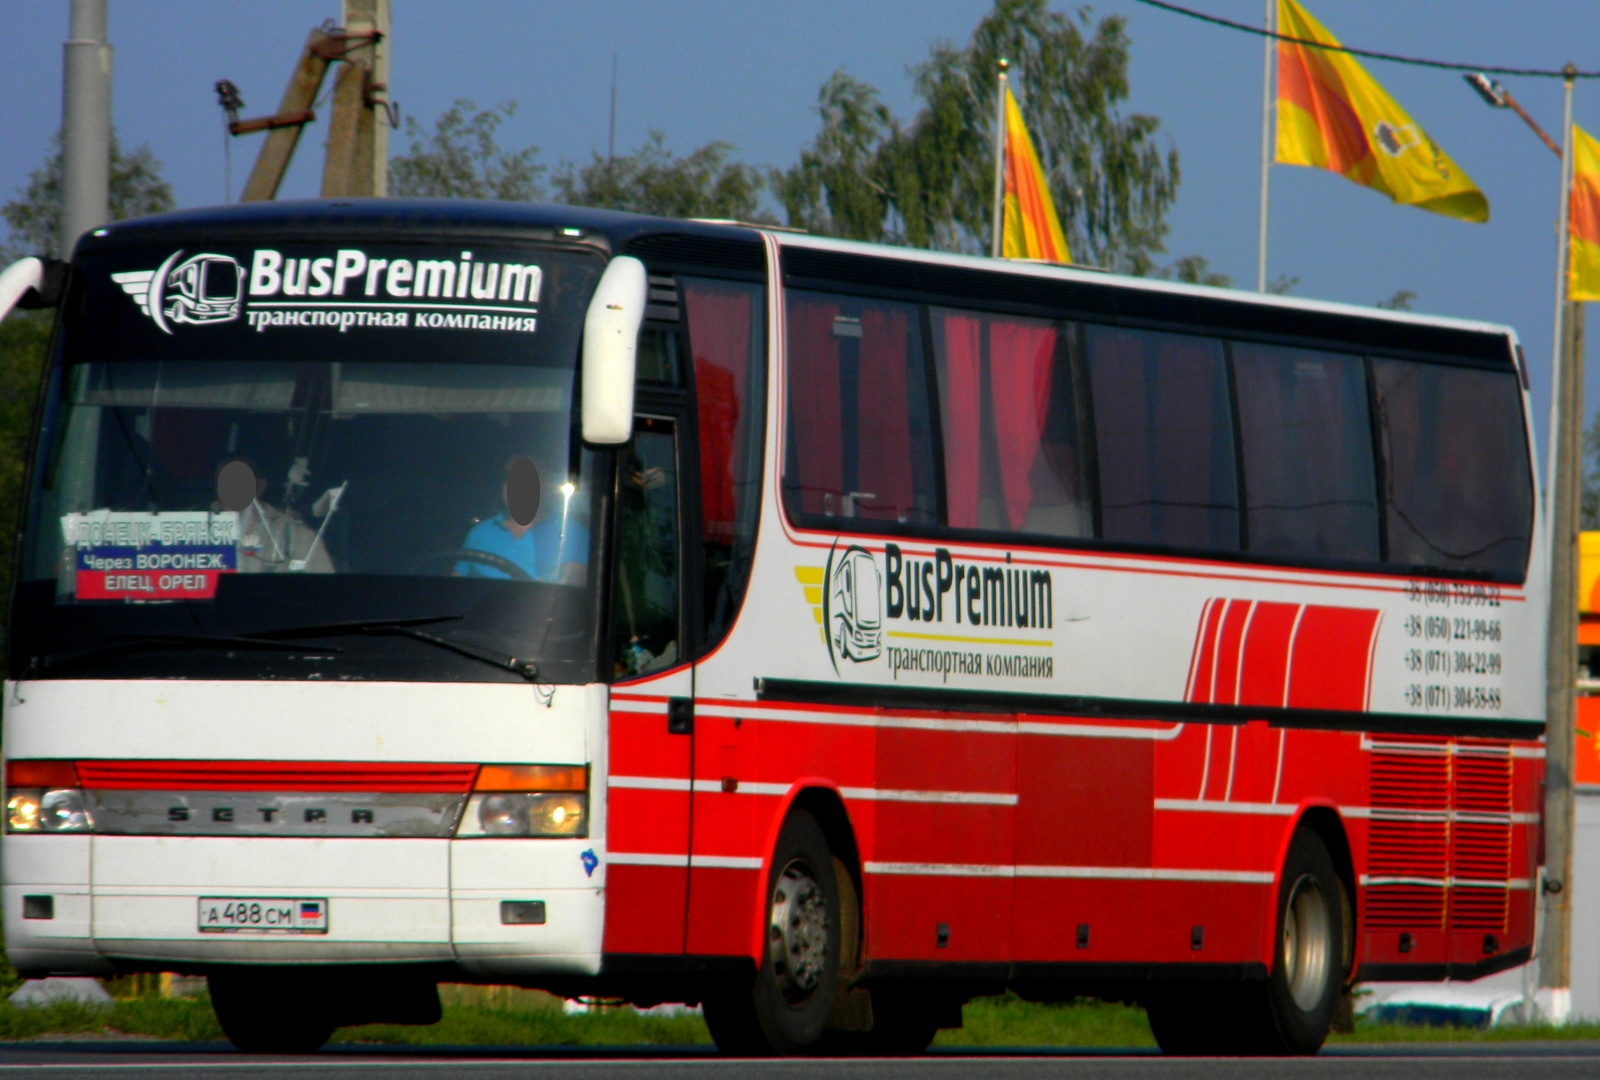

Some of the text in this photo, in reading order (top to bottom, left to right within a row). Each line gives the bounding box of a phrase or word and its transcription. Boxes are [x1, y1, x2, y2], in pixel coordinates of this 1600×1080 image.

[248, 249, 542, 303] BusPremium
[246, 310, 537, 333] транспортная компания
[83, 553, 227, 572] Через ВОРОНЕЖ,
[104, 574, 206, 592] ЕЛЕЦ, ОРЕЛ
[884, 542, 1054, 629] BusPremium
[886, 645, 1054, 684] транспортная компания
[168, 806, 374, 824] SETRA
